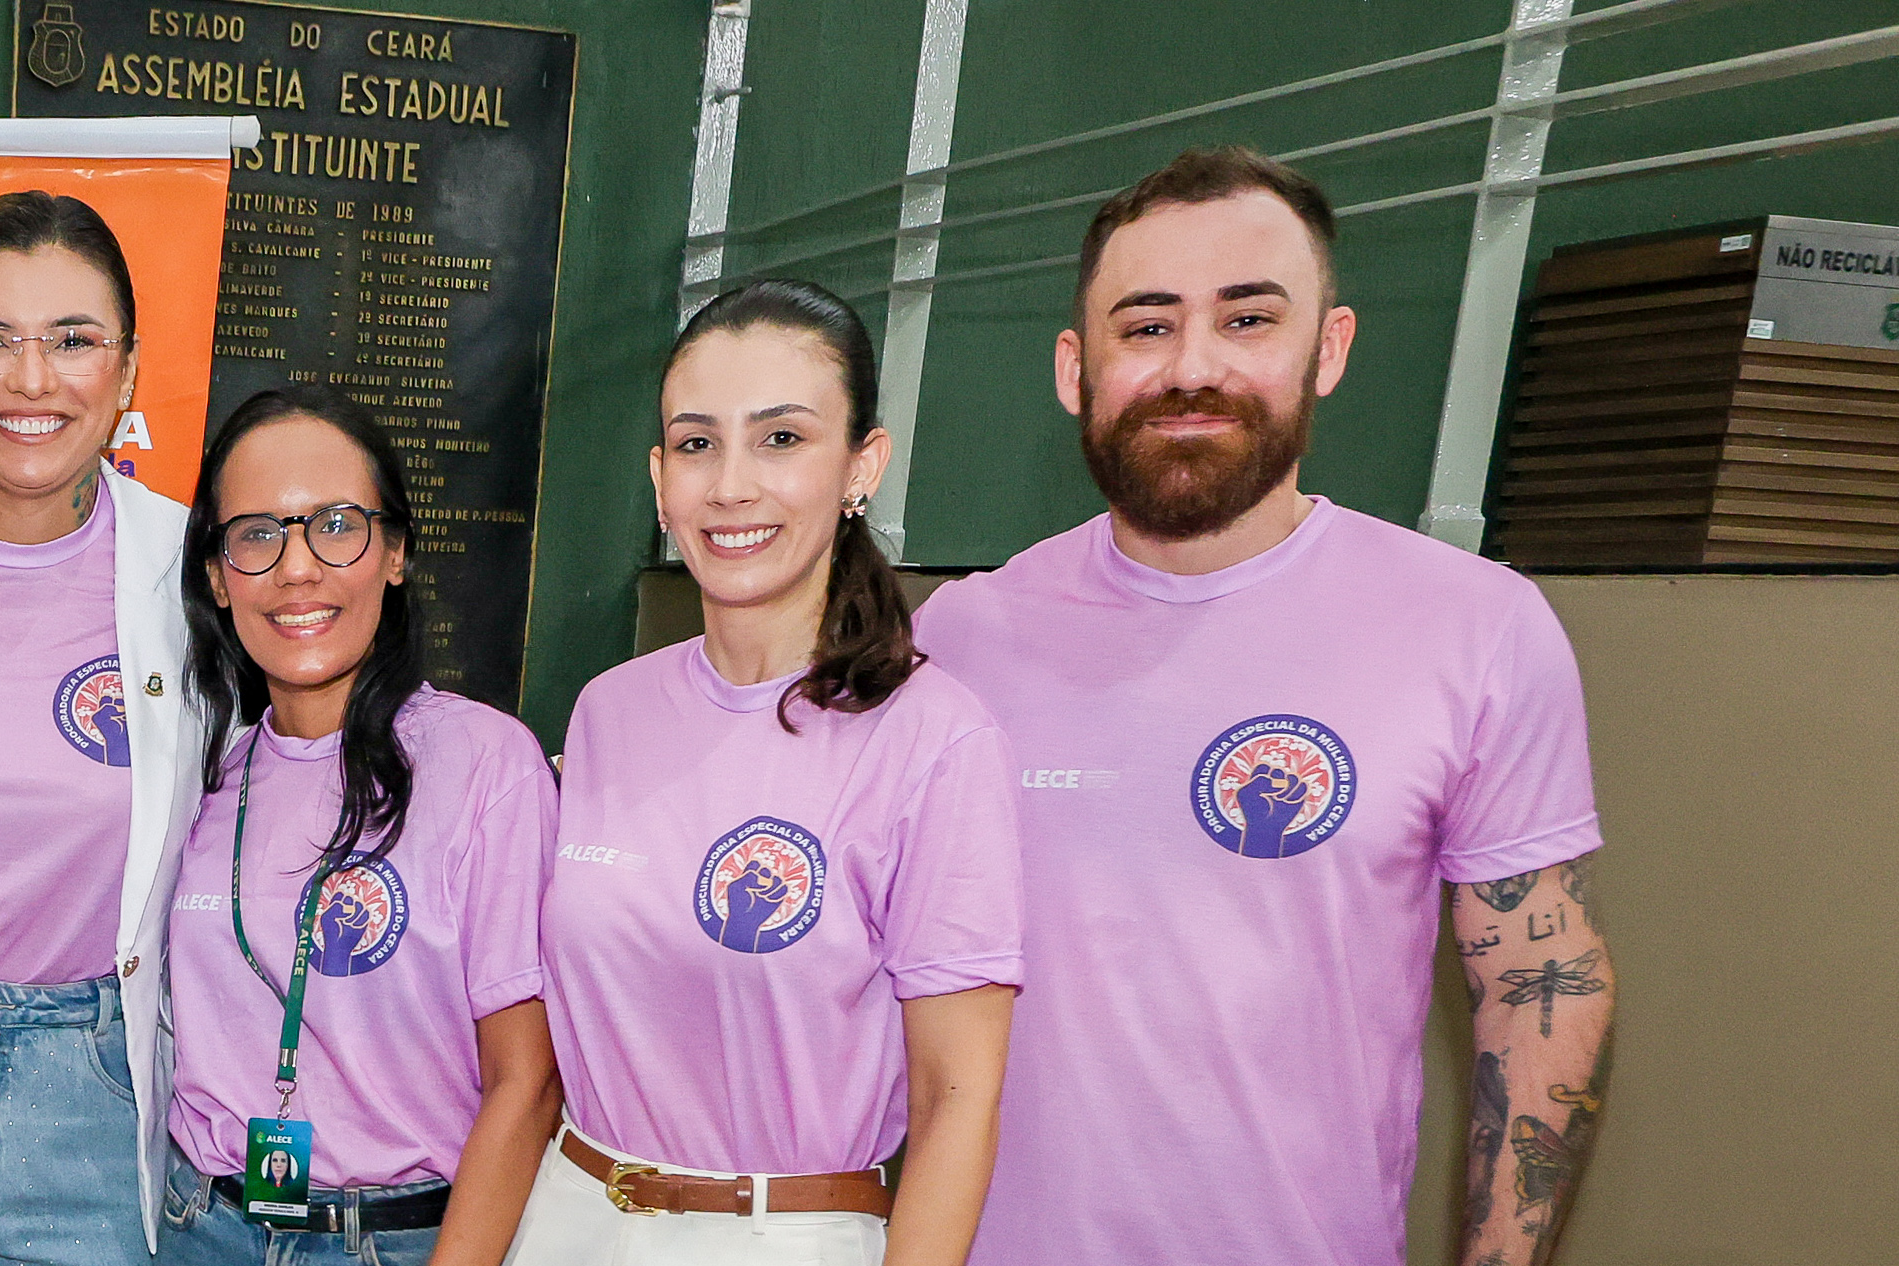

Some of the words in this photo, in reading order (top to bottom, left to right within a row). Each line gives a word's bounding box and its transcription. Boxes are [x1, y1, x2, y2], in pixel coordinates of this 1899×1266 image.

[149, 8, 244, 43] ESTADO
[290, 22, 321, 50] DO
[367, 30, 453, 62] CEARÁ
[97, 53, 305, 110] ASSEMBLÉIA
[339, 72, 510, 128] ESTADUAL
[336, 201, 355, 219] DE
[373, 203, 413, 223] 1989
[362, 229, 434, 245] PRESIDENTE
[248, 243, 321, 259] CAVALCANTE
[382, 252, 407, 264] VICE
[422, 255, 492, 270] PRESIDENTE
[1776, 243, 1815, 269] NÃO
[1819, 250, 1899, 276] RECICLÁ
[381, 273, 405, 285] VICE
[421, 276, 489, 291] PRESIDENTE
[245, 305, 298, 318] MARQUES
[214, 345, 286, 360] CAVALCANTE
[401, 377, 454, 390] SILVEIRA
[426, 418, 461, 430] PINHO
[390, 437, 426, 449] AMPOS
[59, 677, 90, 749] PROCURADORIA
[76, 660, 119, 679] ESPECIA
[1022, 769, 1081, 788] LECE
[1197, 741, 1232, 834] PROCURADORIA
[1229, 720, 1296, 743] ESPECIAL
[1297, 724, 1317, 737] DA
[1316, 733, 1351, 782] MULHER
[1337, 784, 1351, 804] DO
[558, 843, 620, 865] ALECE
[698, 837, 737, 921] PROCURADORIA
[737, 822, 792, 840] ESPECIAL
[792, 833, 810, 848] DA
[811, 888, 823, 907] DO
[382, 868, 405, 914] MULHER
[173, 894, 222, 911] ALECE
[392, 915, 404, 932] DO
[294, 928, 310, 976] ALECE
[266, 1135, 293, 1144] ALECE
